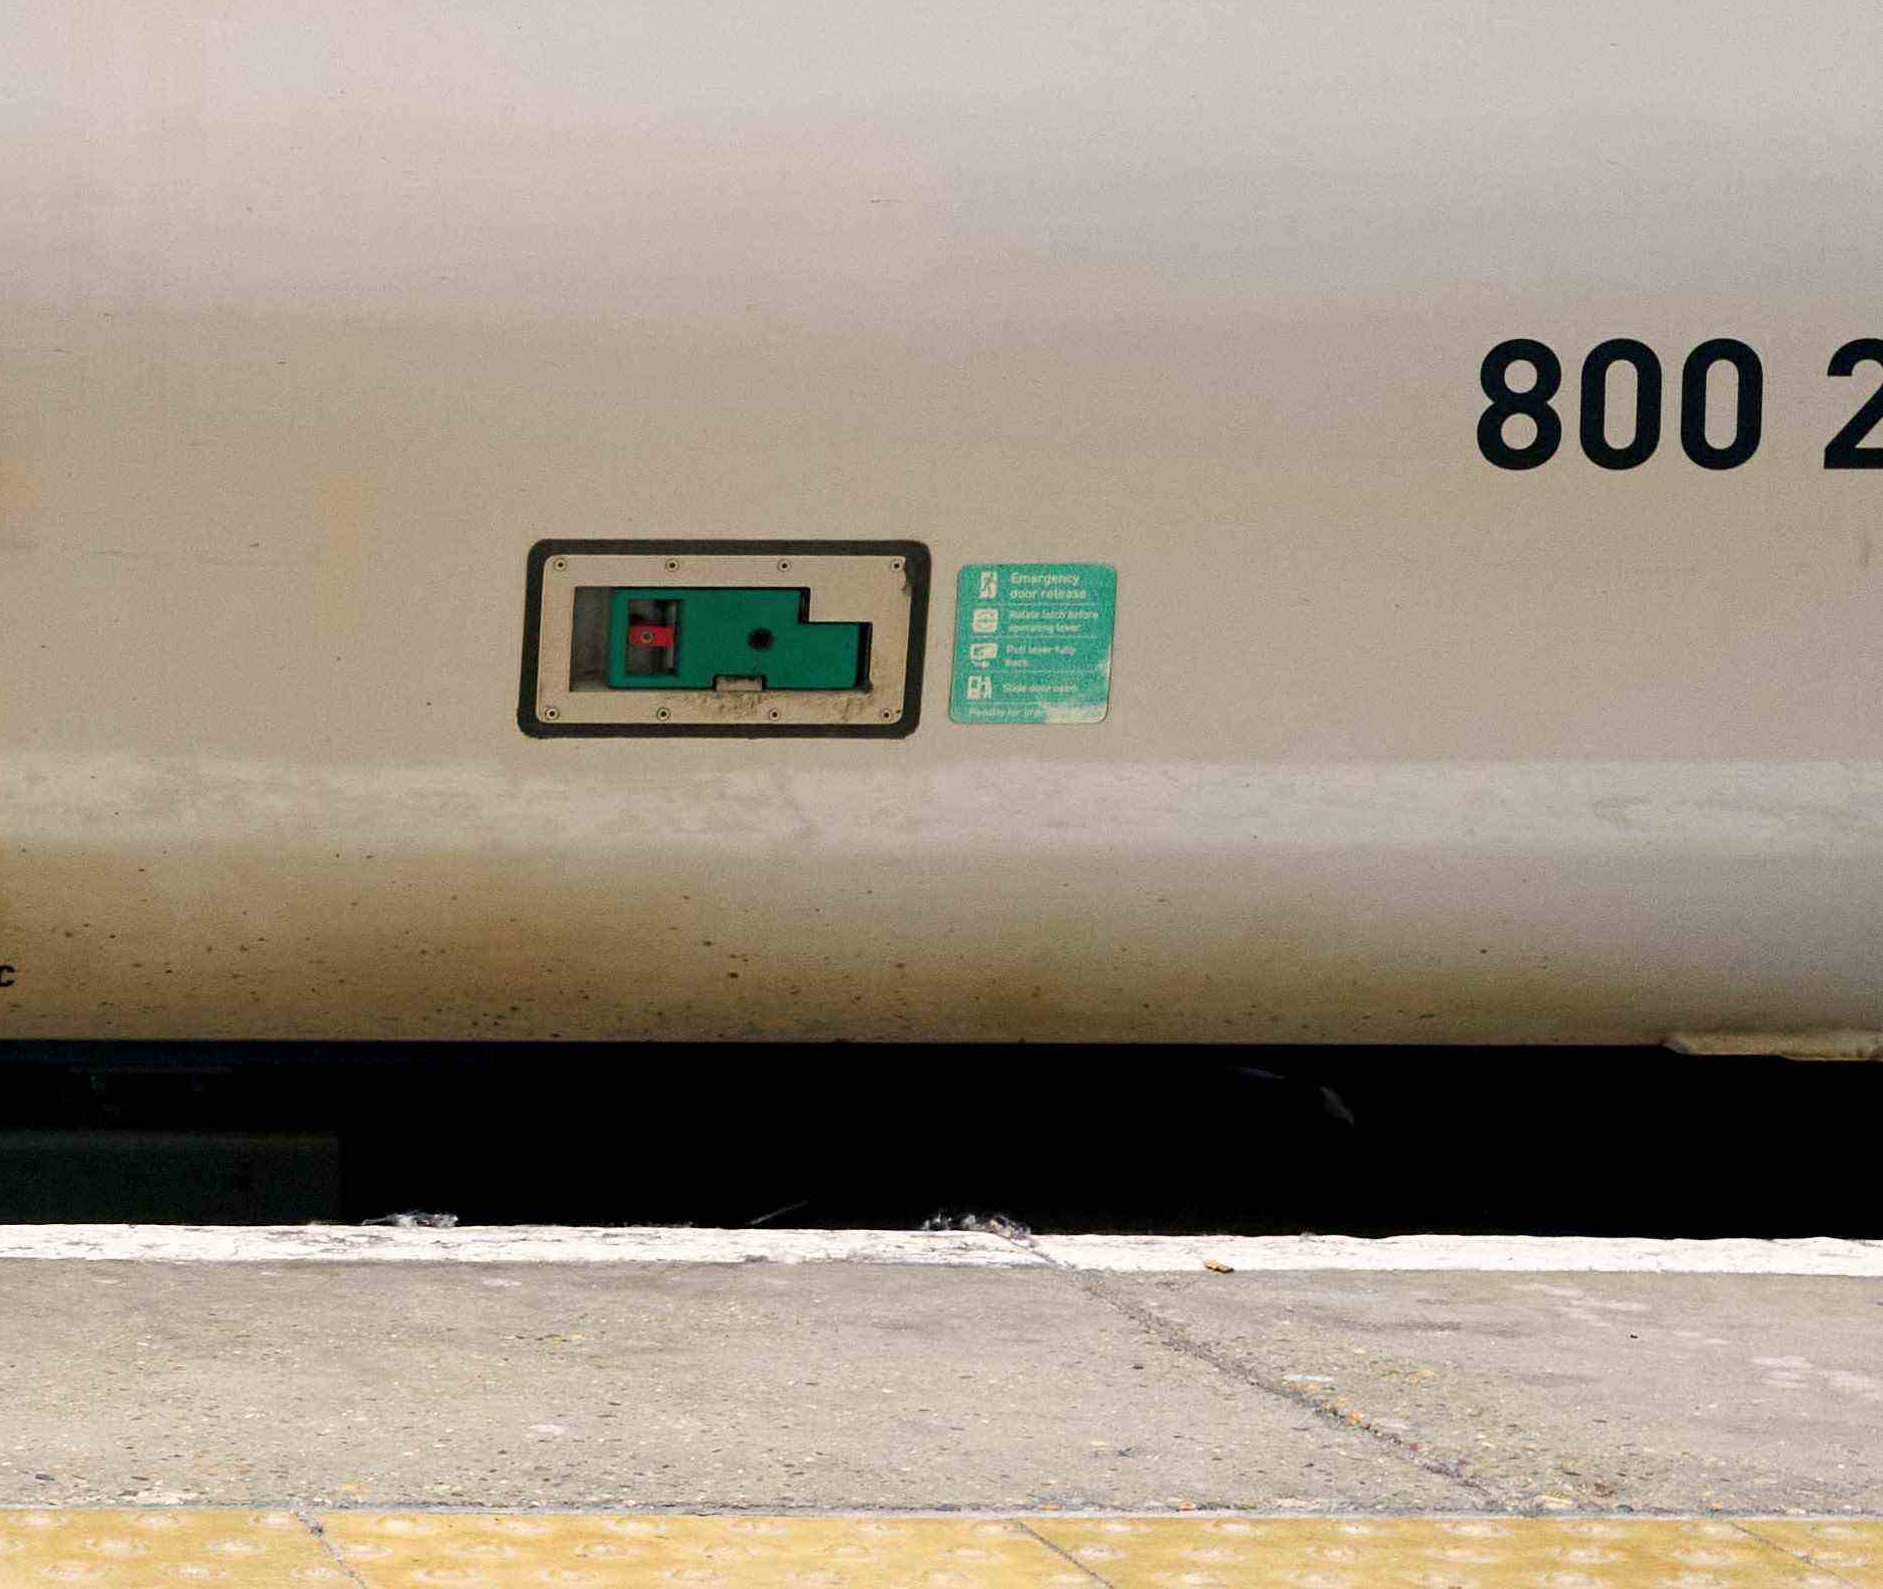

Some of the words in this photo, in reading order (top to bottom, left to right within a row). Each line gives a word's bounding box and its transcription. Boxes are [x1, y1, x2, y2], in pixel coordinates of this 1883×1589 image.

[1476, 337, 1764, 472] 800
[1823, 337, 1883, 470] 2
[1010, 572, 1080, 586] Emergency
[1010, 589, 1038, 599] door
[1041, 589, 1087, 599] release
